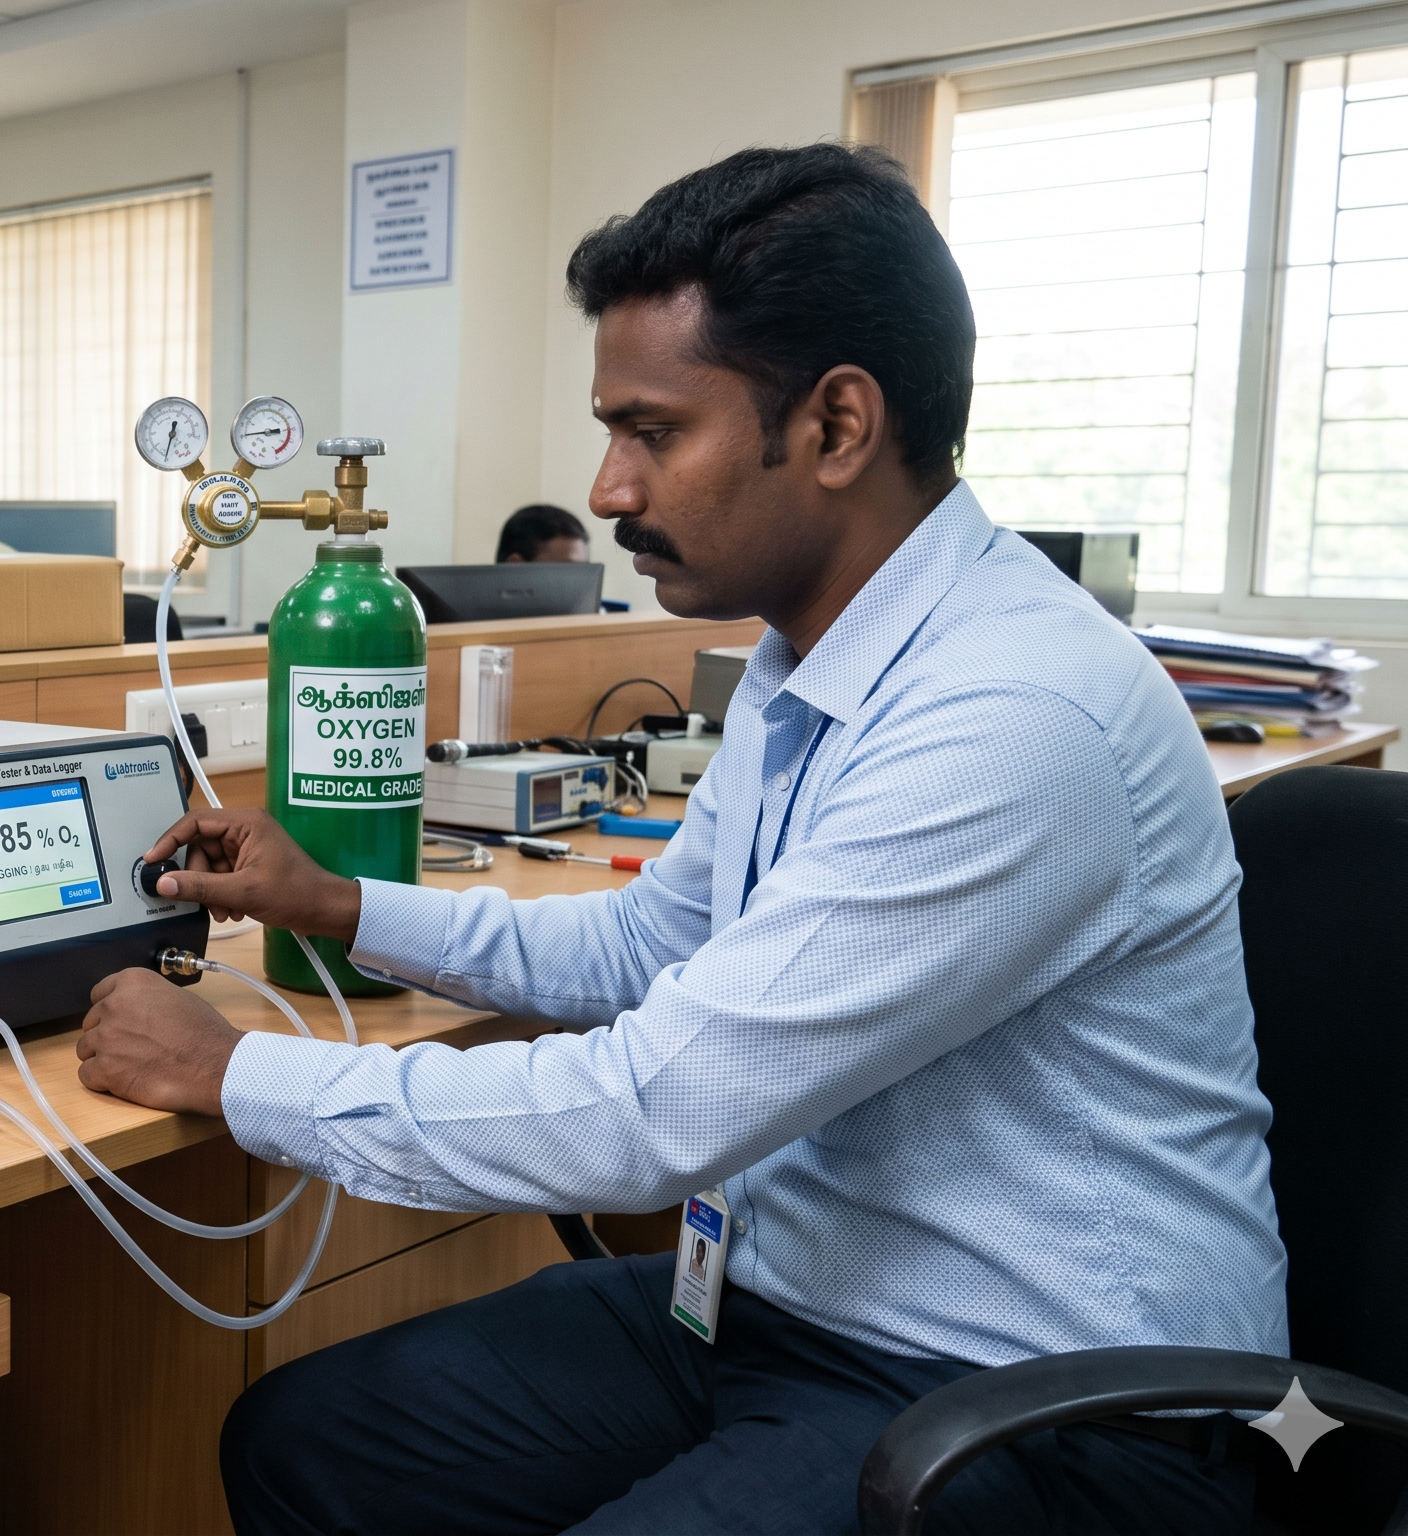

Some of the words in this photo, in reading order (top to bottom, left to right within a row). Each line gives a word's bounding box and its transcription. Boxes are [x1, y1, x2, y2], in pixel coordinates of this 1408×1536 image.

[316, 717, 416, 740] OXYGEN
[24, 765, 31, 776] &
[32, 764, 52, 775] Data
[53, 761, 82, 774] Logger
[333, 747, 403, 769] 99.8%
[300, 779, 377, 797] MEDICAL
[380, 778, 422, 797] GRADE
[37, 828, 54, 849] %
